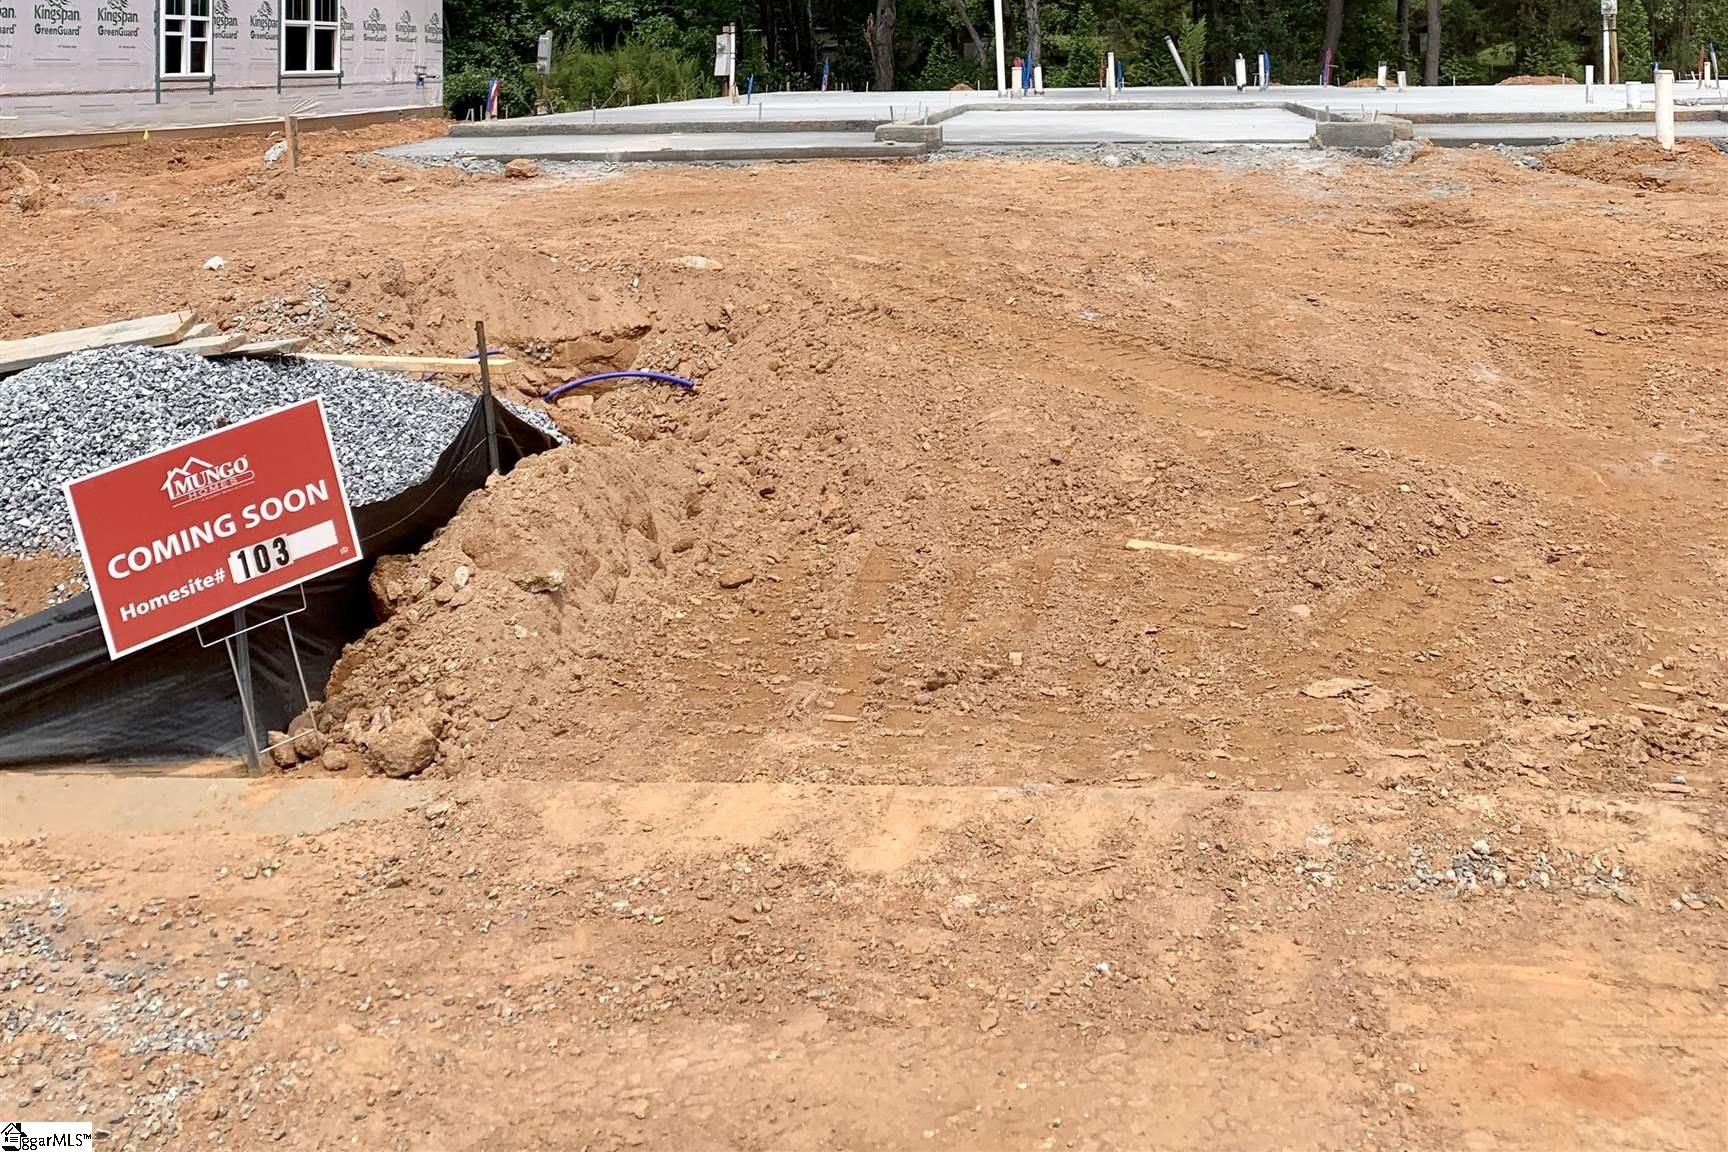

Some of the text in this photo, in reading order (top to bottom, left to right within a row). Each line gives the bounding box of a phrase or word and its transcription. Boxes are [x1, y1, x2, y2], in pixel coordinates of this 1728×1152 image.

[34, 5, 80, 24] Kingspan
[97, 7, 138, 25] Kingspan
[213, 16, 238, 29] ngspan
[34, 23, 80, 36] GreenGuard
[97, 25, 138, 37] GreenGuard
[173, 456, 248, 496] MUNGO
[188, 477, 237, 499] HOMES
[107, 479, 329, 580] COMING SOON
[119, 536, 290, 622] Homesite# 103
